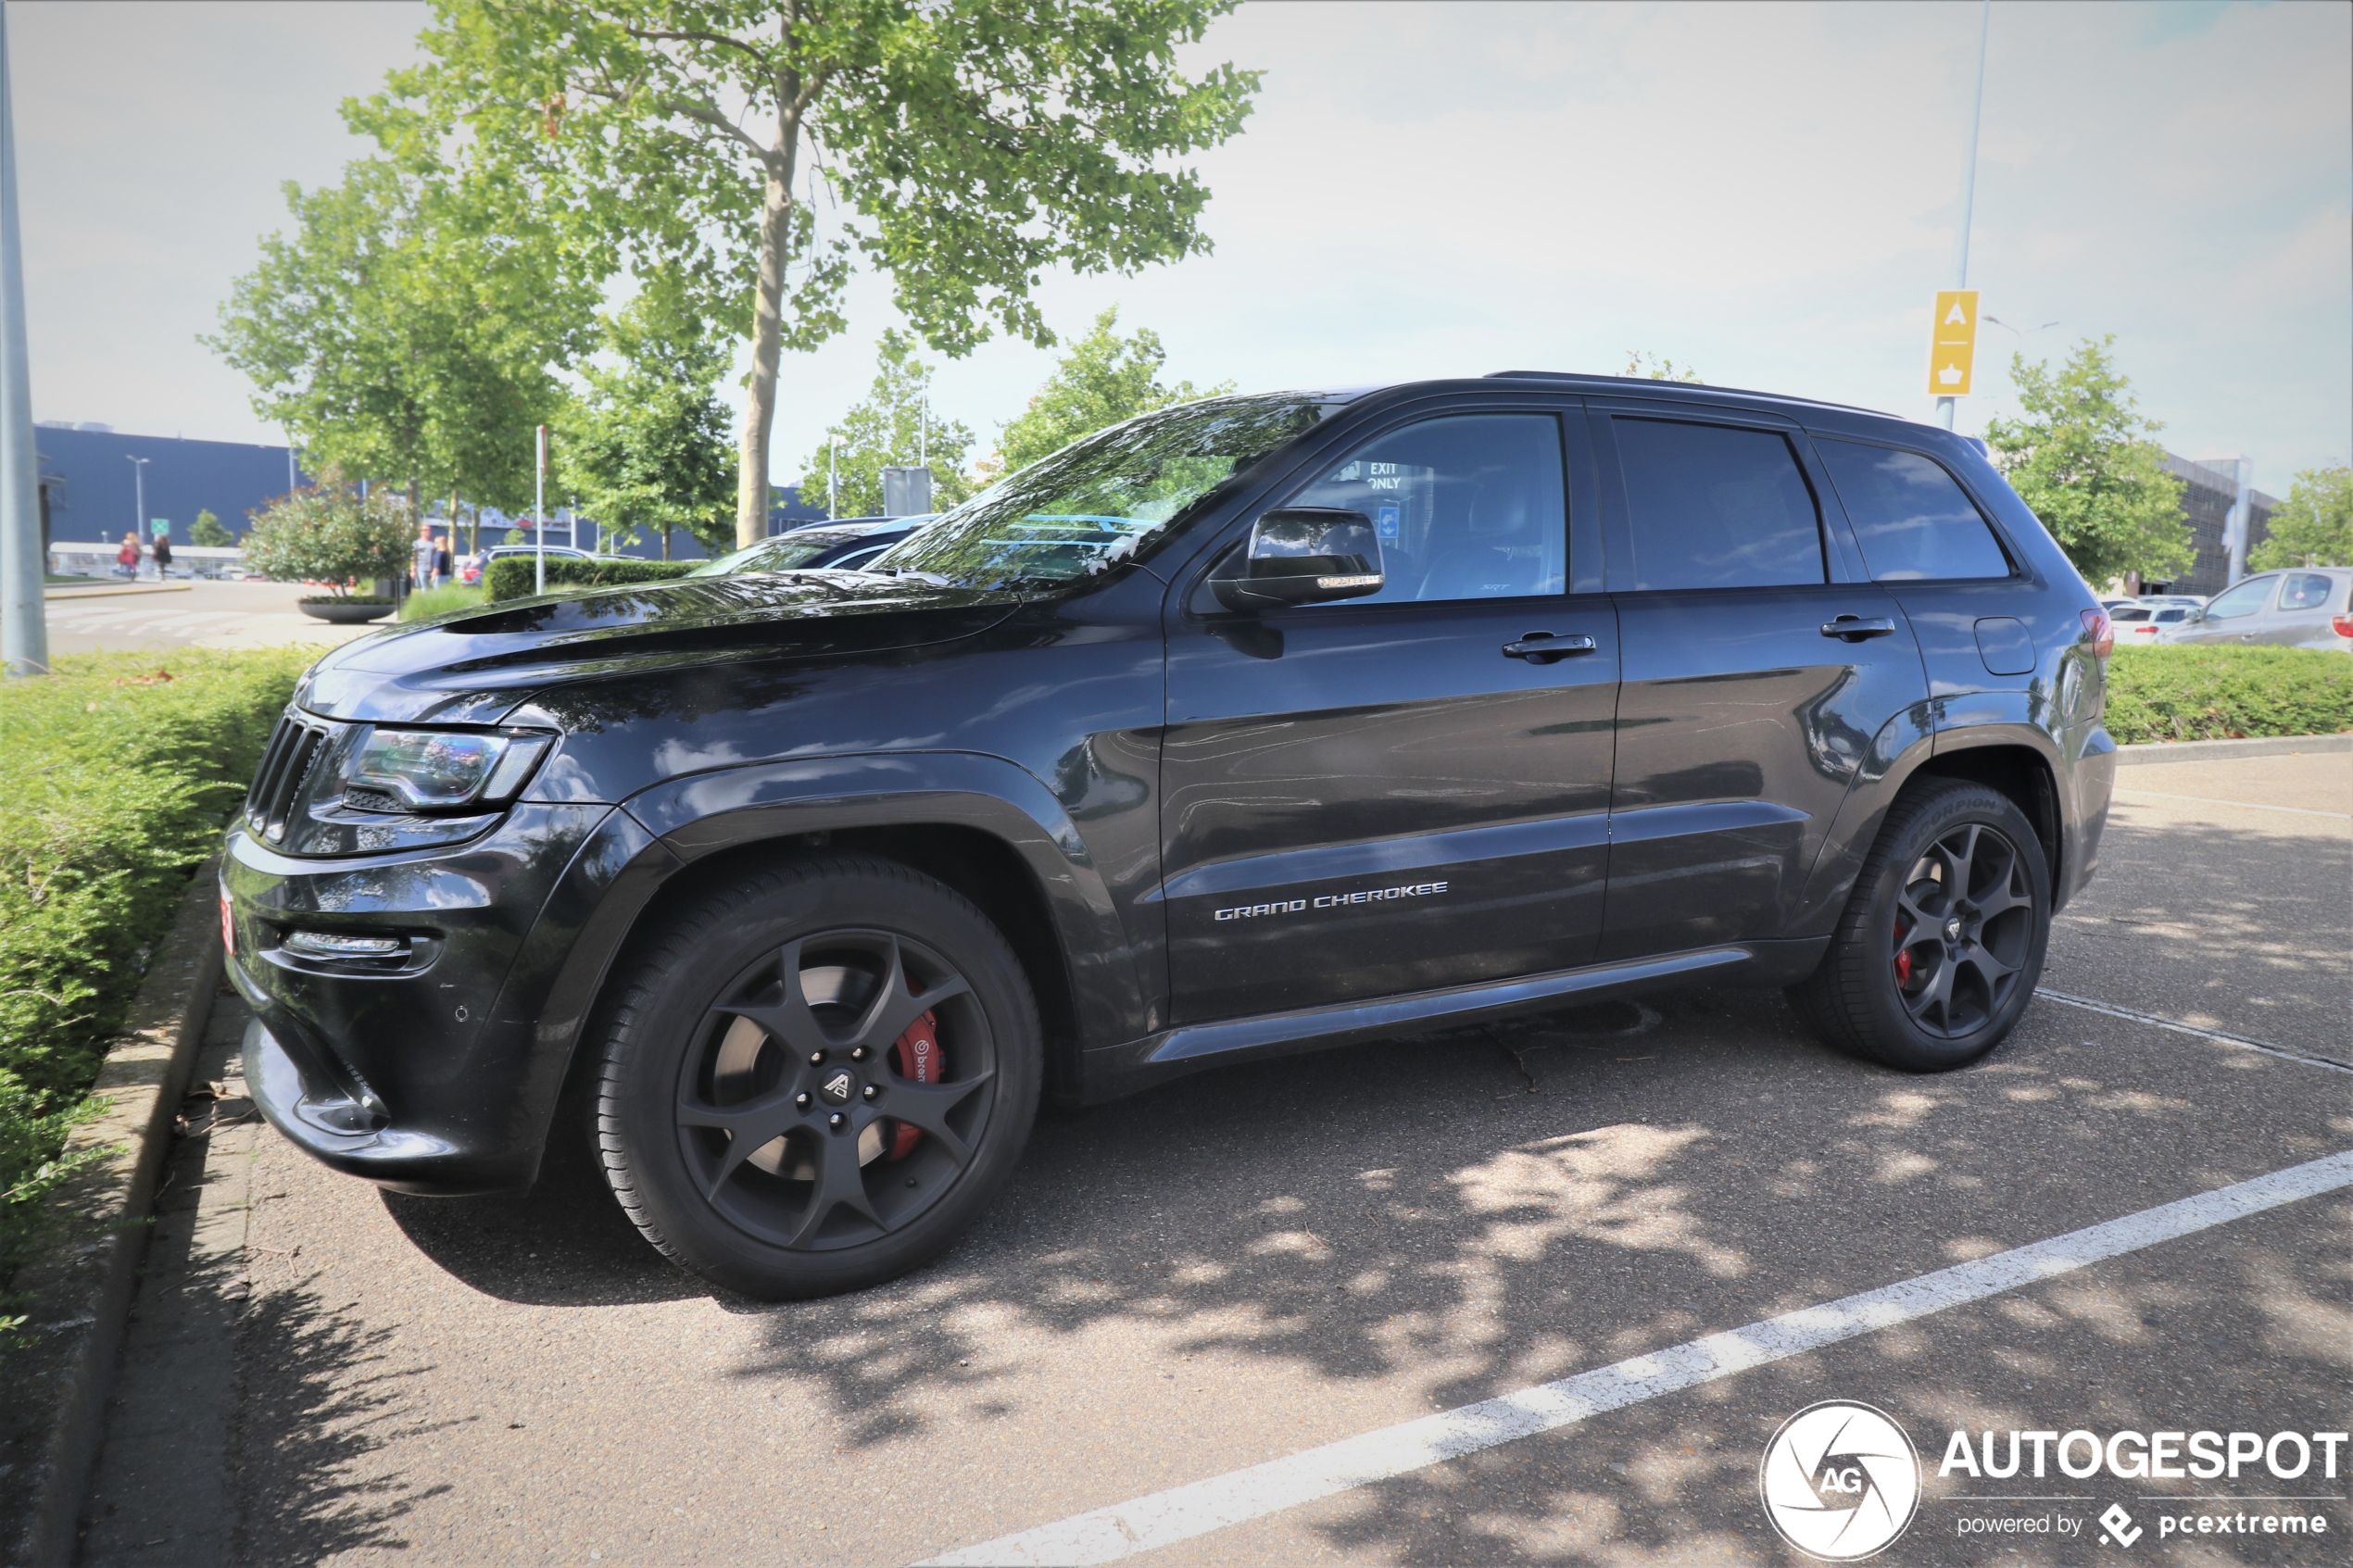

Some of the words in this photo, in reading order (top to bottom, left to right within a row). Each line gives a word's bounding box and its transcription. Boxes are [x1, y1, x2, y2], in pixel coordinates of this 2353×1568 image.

[1944, 303, 1967, 325] A
[1371, 463, 1397, 474] EXIT
[1214, 899, 1306, 921] GRAND
[1314, 882, 1448, 909] CHEROKEE
